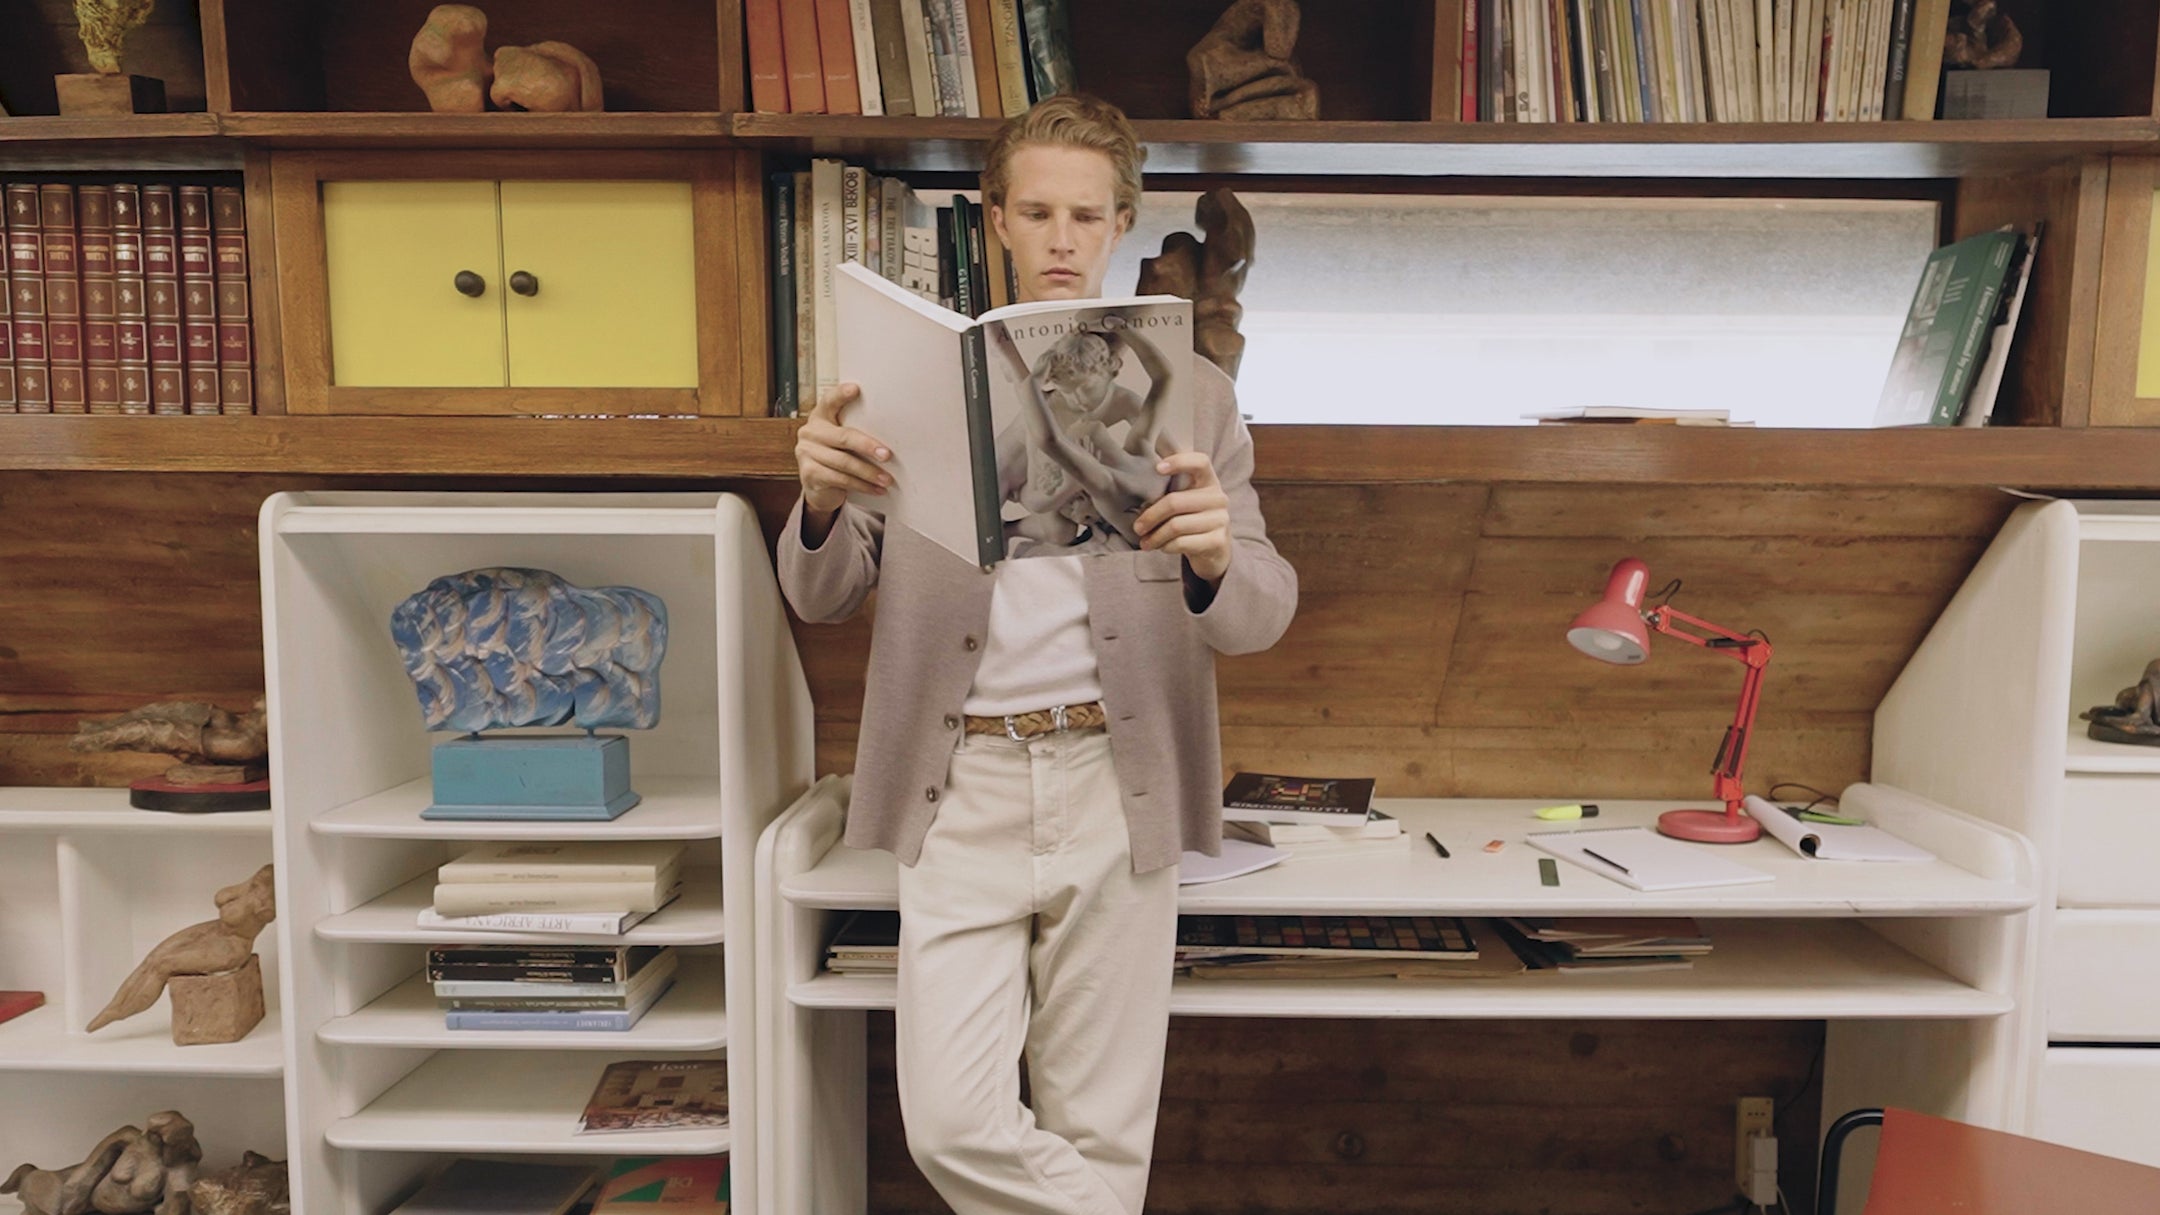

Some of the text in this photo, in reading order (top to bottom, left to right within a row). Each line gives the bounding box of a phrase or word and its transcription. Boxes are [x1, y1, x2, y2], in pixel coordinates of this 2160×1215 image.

[958, 268, 968, 313] Ghirlan
[999, 314, 1184, 342] Antonio Canova
[970, 369, 979, 399] Canova
[538, 916, 574, 930] ARTE
